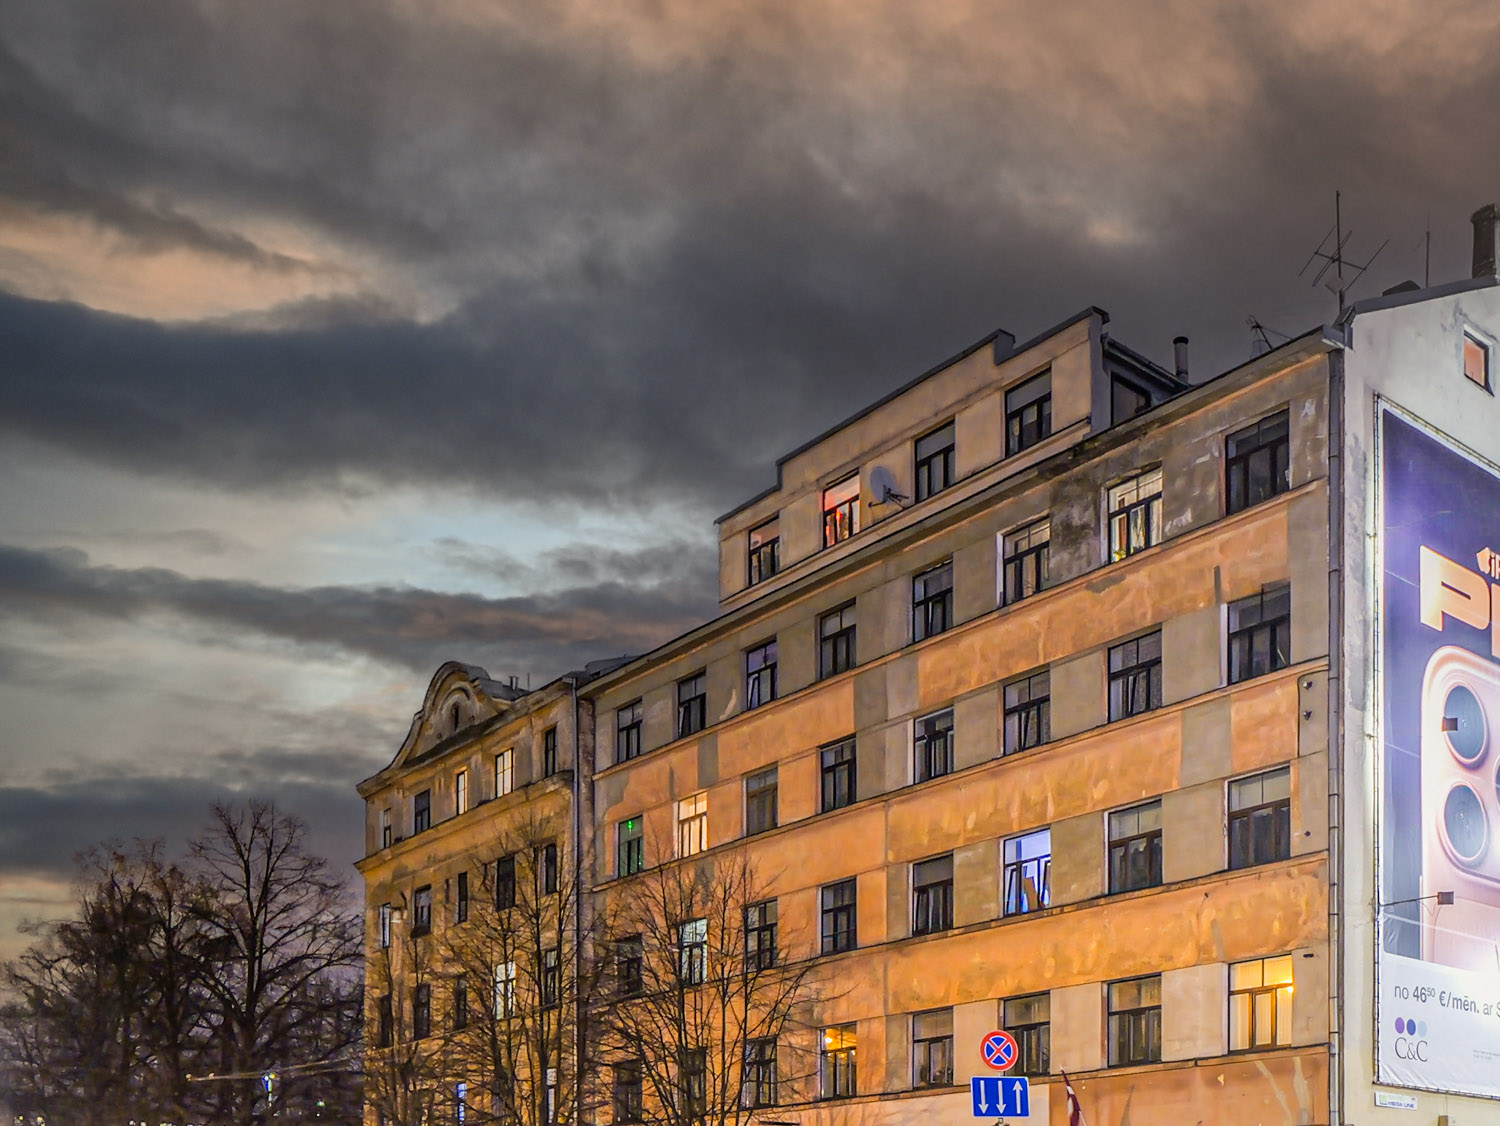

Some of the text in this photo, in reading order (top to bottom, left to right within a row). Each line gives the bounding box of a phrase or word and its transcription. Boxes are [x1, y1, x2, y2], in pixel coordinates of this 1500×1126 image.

[1394, 984, 1409, 1000] no
[1438, 990, 1480, 1014] €/mēn.
[1483, 1004, 1493, 1016] ar
[1394, 1037, 1428, 1062] C&C
